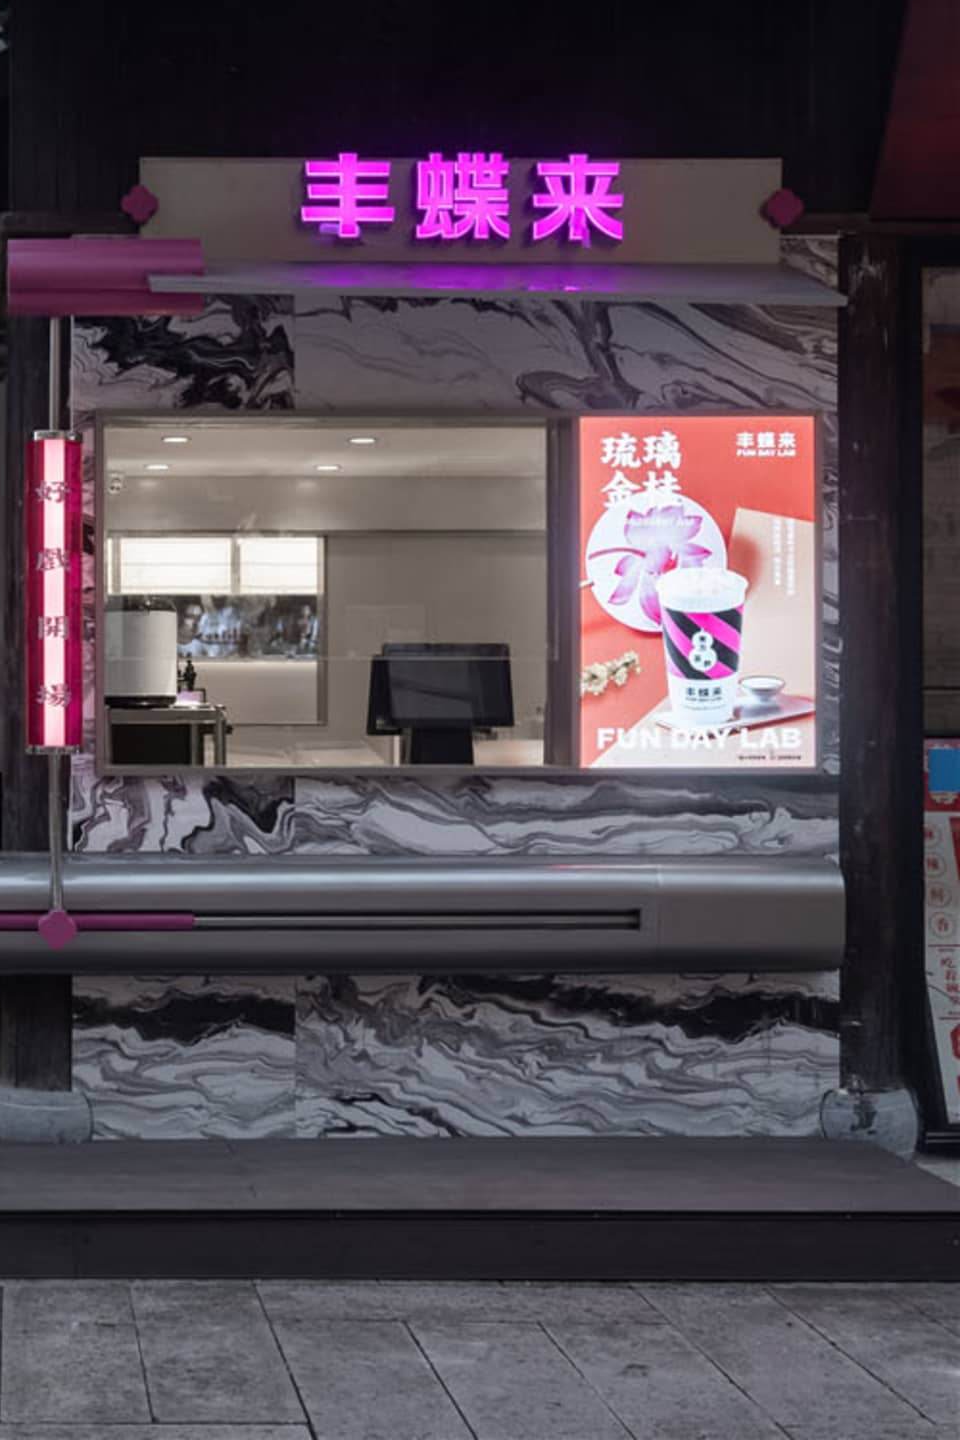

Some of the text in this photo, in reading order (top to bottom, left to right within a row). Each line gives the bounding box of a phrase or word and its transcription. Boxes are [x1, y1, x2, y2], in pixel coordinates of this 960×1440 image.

[301, 152, 624, 240] 丰蝶来
[600, 430, 682, 469] 琉璃
[596, 727, 802, 750] FUN DAY LAB
